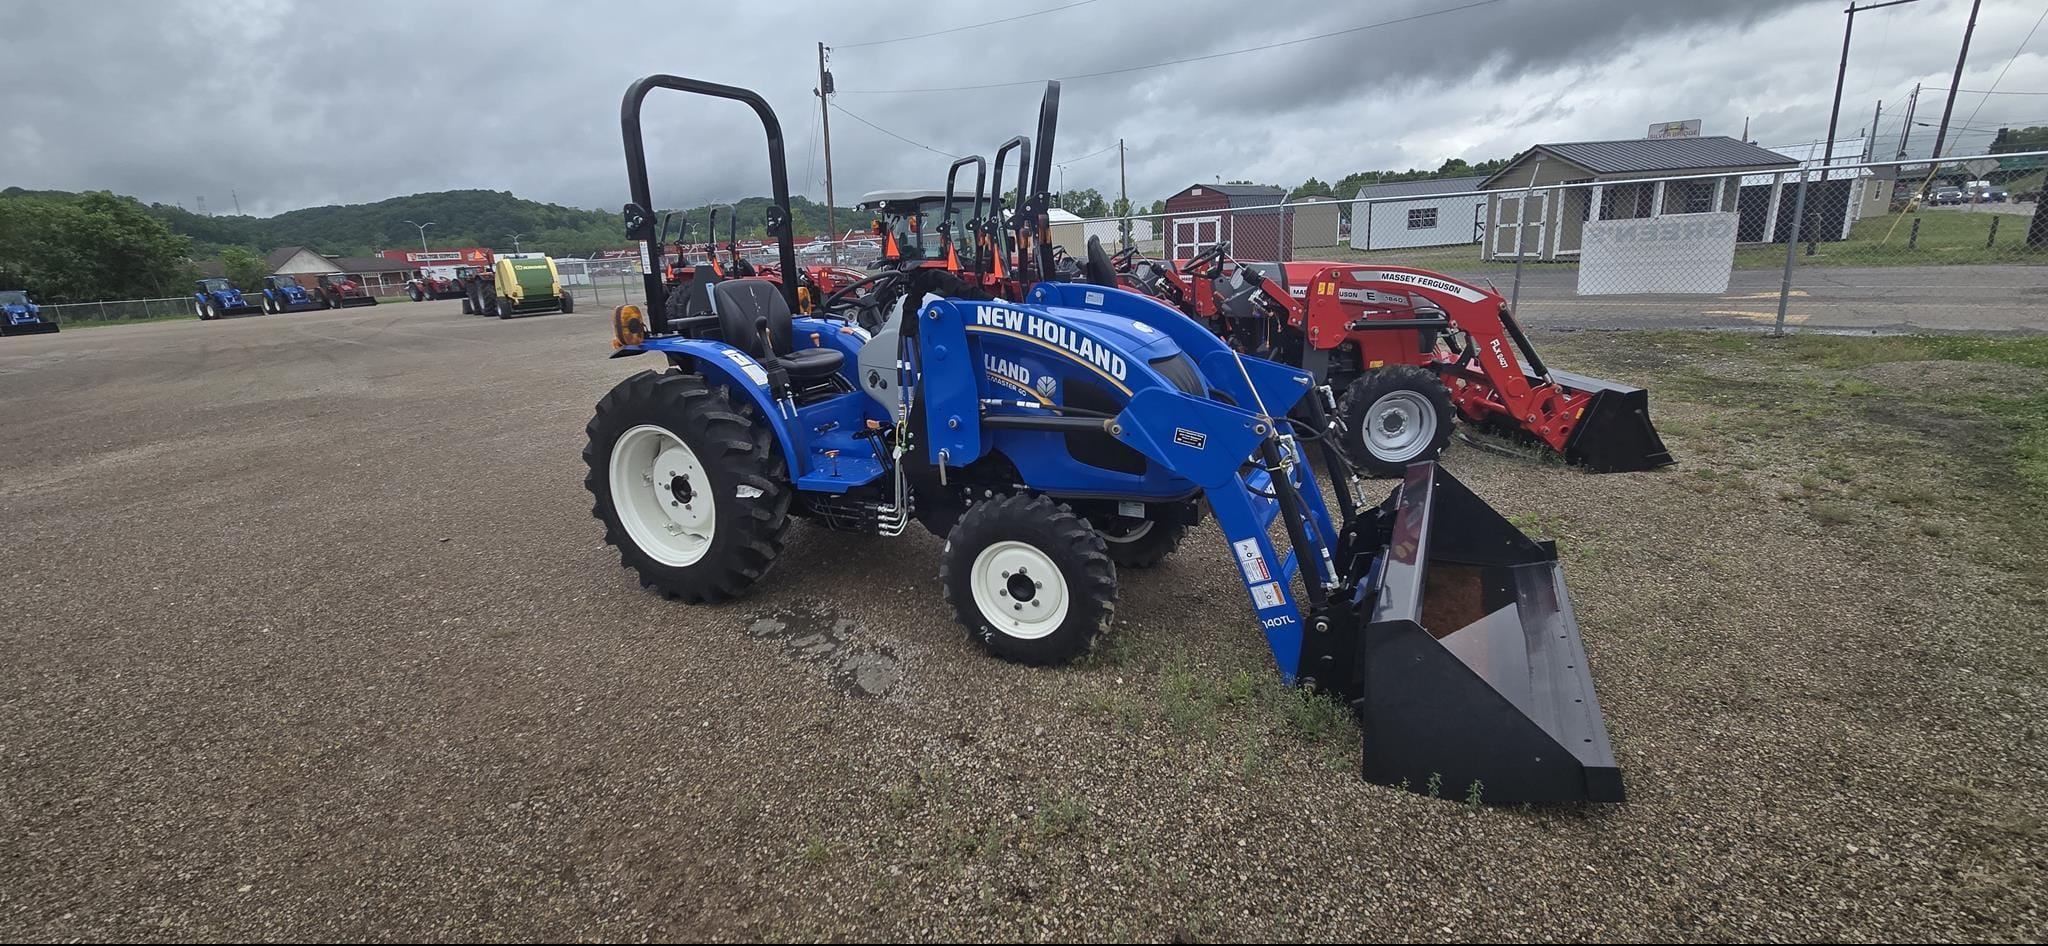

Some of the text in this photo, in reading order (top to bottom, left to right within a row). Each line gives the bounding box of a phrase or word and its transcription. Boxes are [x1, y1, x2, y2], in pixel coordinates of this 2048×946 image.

[1381, 273, 1461, 294] MASSEY FERGUSON
[977, 305, 1127, 381] NEW HOLLAND
[1490, 338, 1502, 355] FLX
